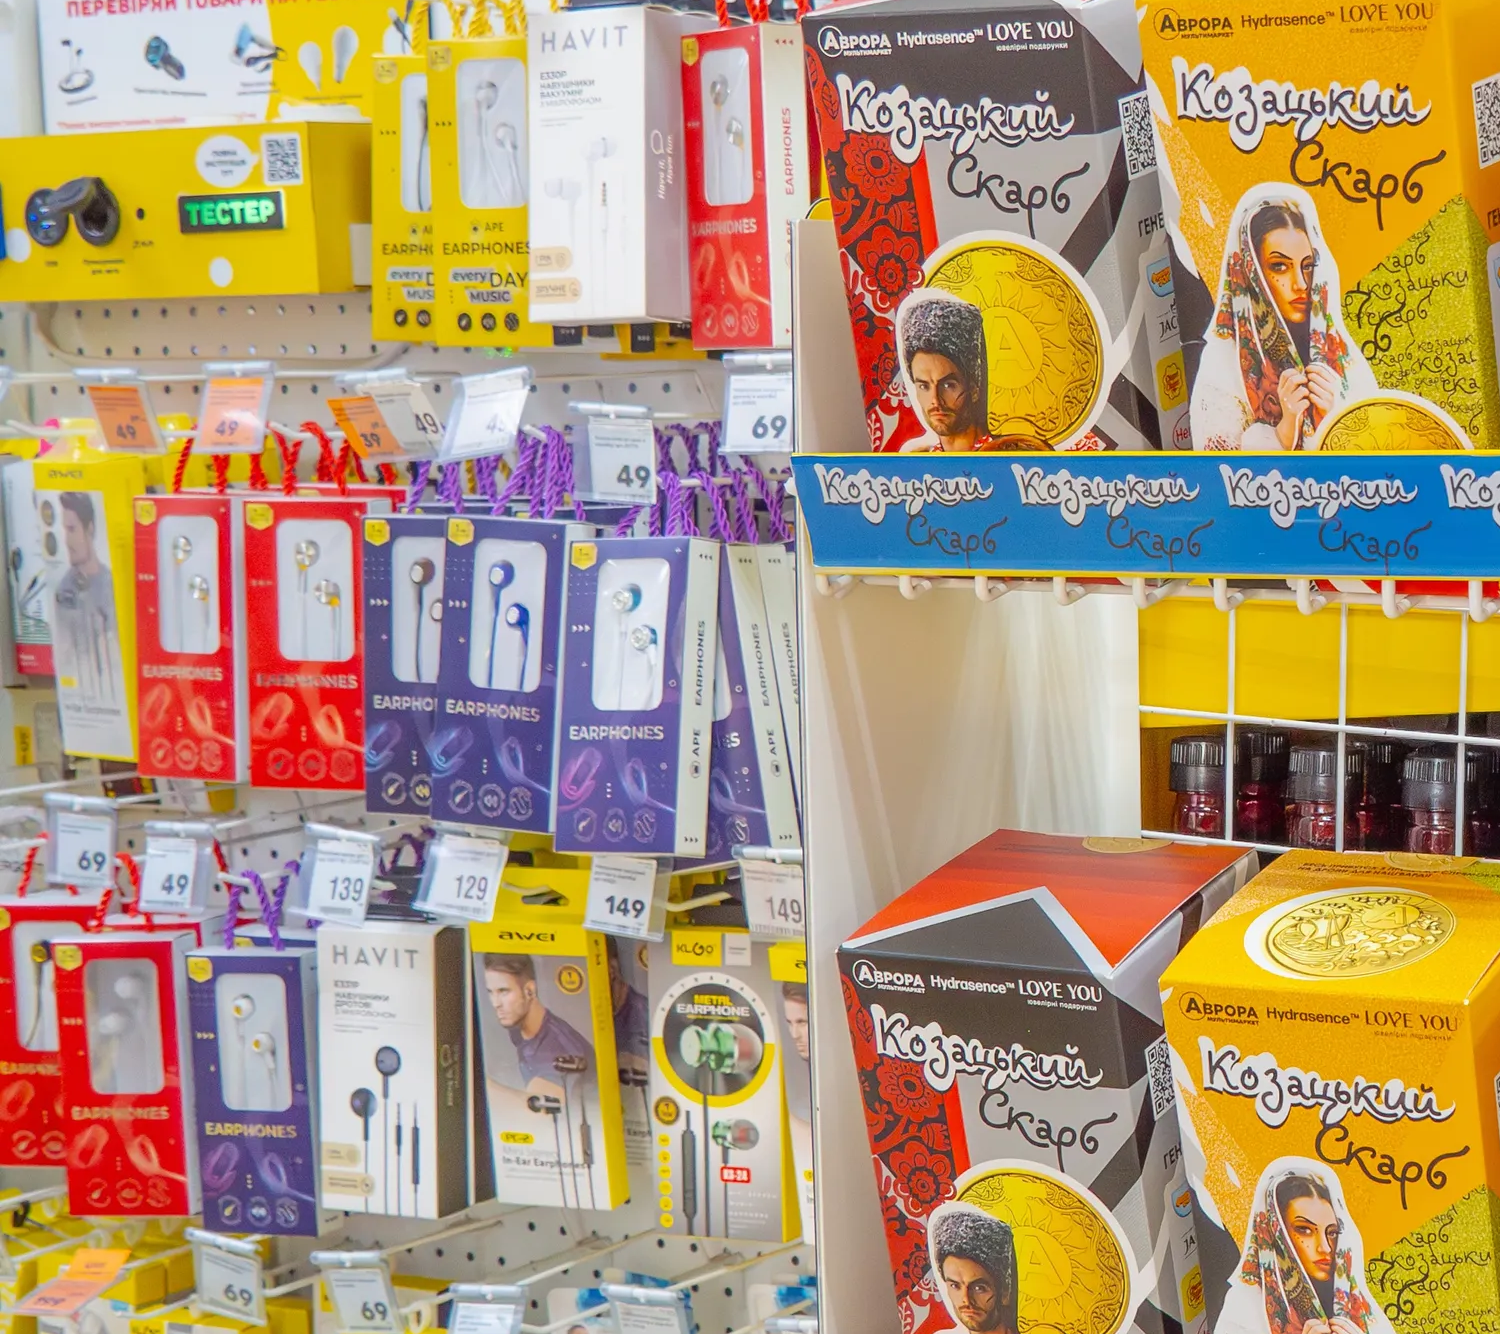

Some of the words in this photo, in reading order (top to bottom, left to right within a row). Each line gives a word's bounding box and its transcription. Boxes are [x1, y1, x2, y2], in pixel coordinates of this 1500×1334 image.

[1341, 5, 1388, 22] LOVE
[1395, 2, 1434, 20] YOU
[541, 25, 629, 54] HAVIT
[987, 23, 1032, 42] LOVE
[1037, 20, 1074, 39] YOU
[1172, 56, 1432, 154] Козацький
[836, 73, 1075, 164] Козацький
[948, 152, 1090, 239] Скарб
[1290, 139, 1446, 231] Скарб
[186, 199, 275, 226] ТЕСТЕР
[452, 269, 486, 283] every
[489, 272, 528, 288] DAY
[469, 291, 511, 303] MUSIC
[752, 416, 788, 439] 69
[617, 465, 650, 487] 49
[814, 464, 993, 525] Козацький
[1011, 464, 1200, 527] Козацький
[1220, 464, 1418, 528] Козацький
[906, 514, 1008, 568] Скарб
[1106, 516, 1215, 572] Скарб
[1319, 517, 1432, 575] Скарб
[695, 620, 706, 706] EARPHONES
[445, 699, 540, 722] EARPHONES
[569, 725, 664, 740] EARPHONES
[79, 851, 107, 873] 69
[162, 875, 190, 896] 49
[329, 878, 364, 902] 139
[455, 875, 488, 901] 129
[606, 896, 645, 919] 149
[332, 945, 420, 969] HAVIT
[1019, 978, 1063, 1000] LOVE
[1067, 982, 1103, 1003] YOU
[676, 1003, 750, 1018] EARPHONE
[1365, 1010, 1415, 1030] LOVE
[1421, 1013, 1458, 1032] YOU
[869, 1003, 1103, 1093] Козацький
[1197, 1036, 1457, 1129] Козацький
[205, 1122, 297, 1139] EARPHONES
[979, 1090, 1118, 1170] Скарб
[1315, 1122, 1470, 1210] Скарб
[223, 1285, 253, 1307] 69
[361, 1302, 388, 1322] 69
